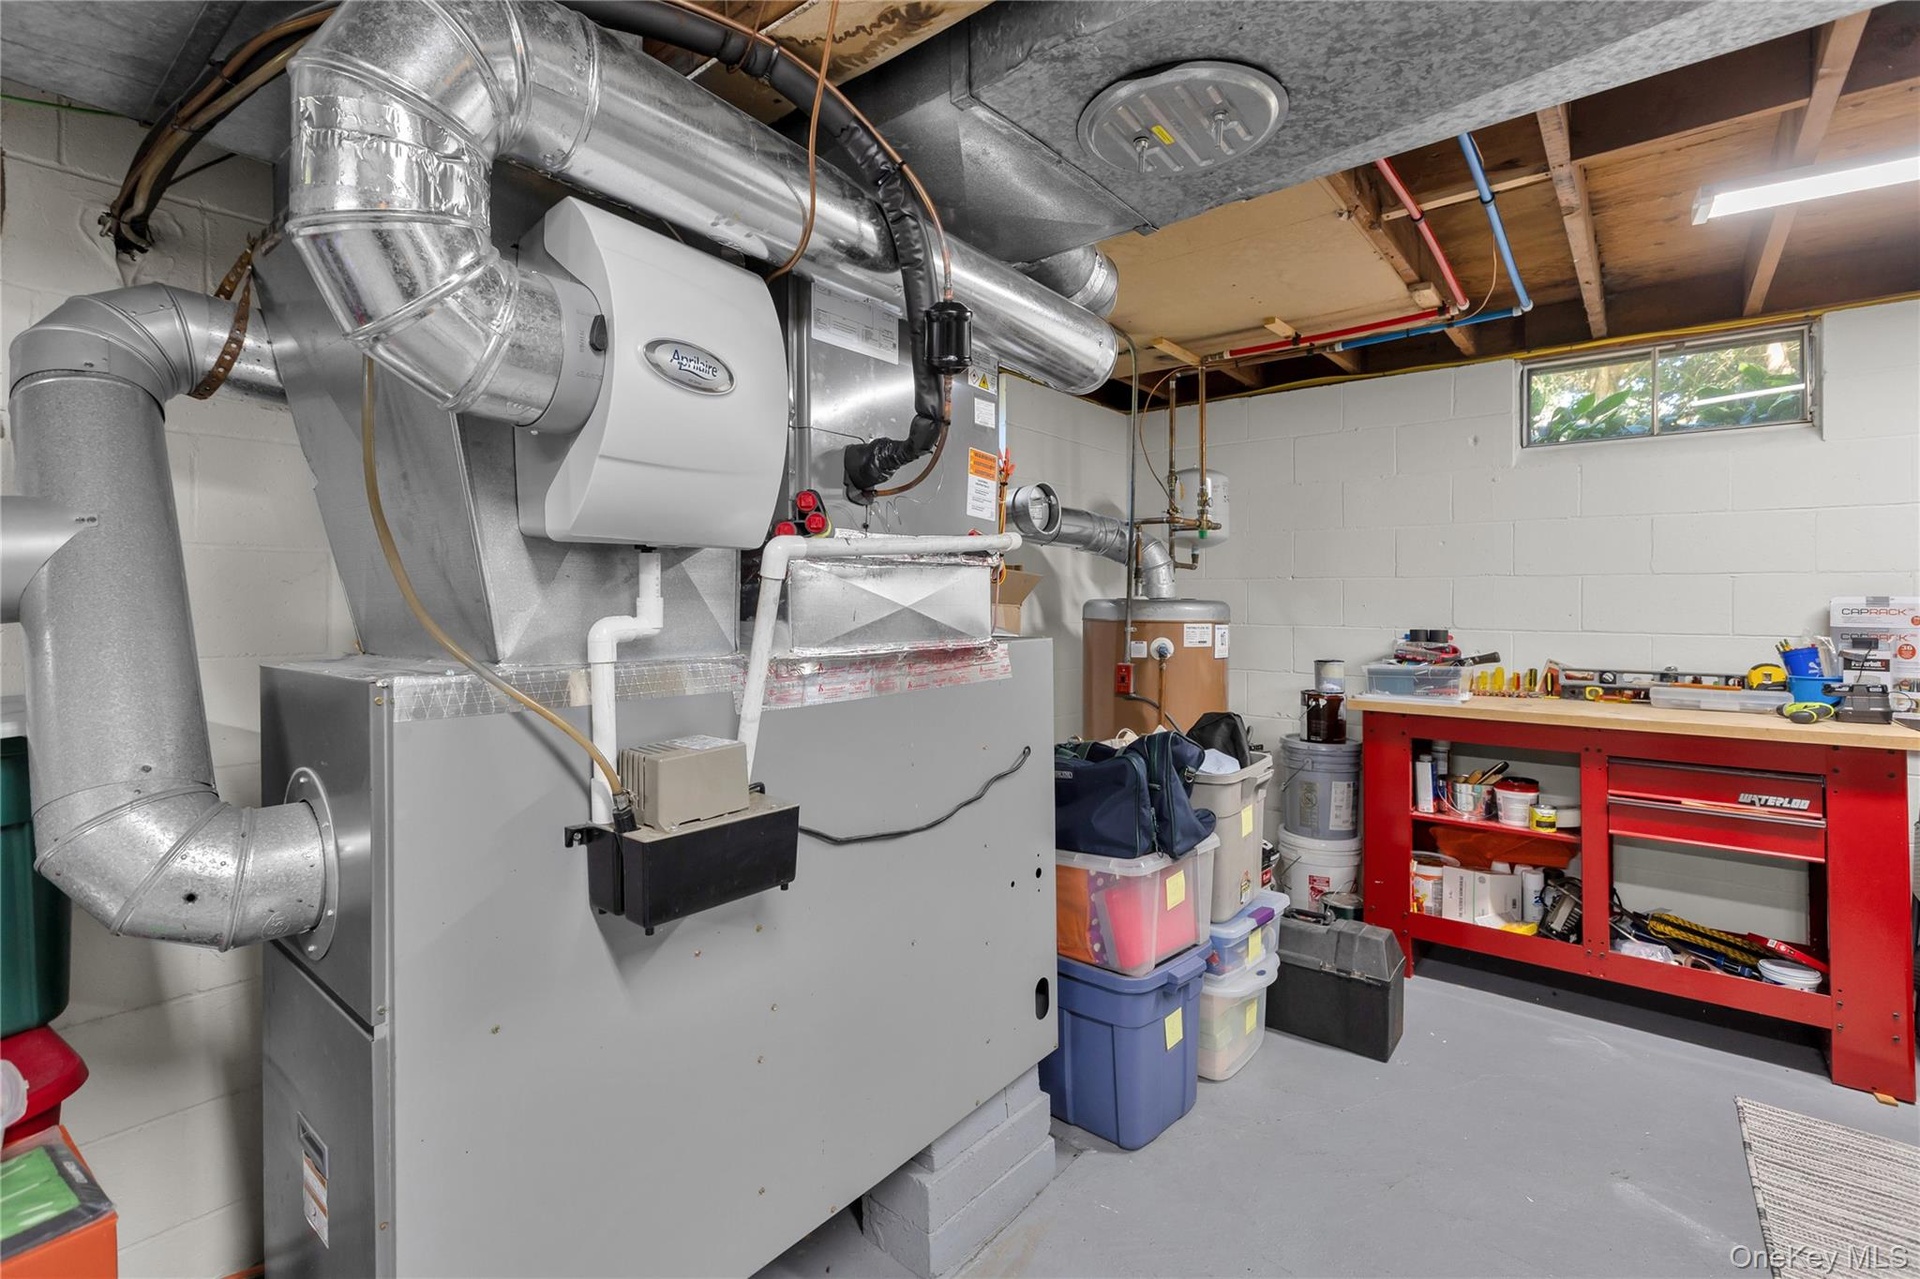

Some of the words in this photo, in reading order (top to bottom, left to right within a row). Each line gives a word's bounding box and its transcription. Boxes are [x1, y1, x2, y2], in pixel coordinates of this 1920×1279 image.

[669, 349, 718, 378] Aprilaire
[1842, 608, 1907, 616] CAPRACK
[1738, 793, 1811, 810] WATERLOO
